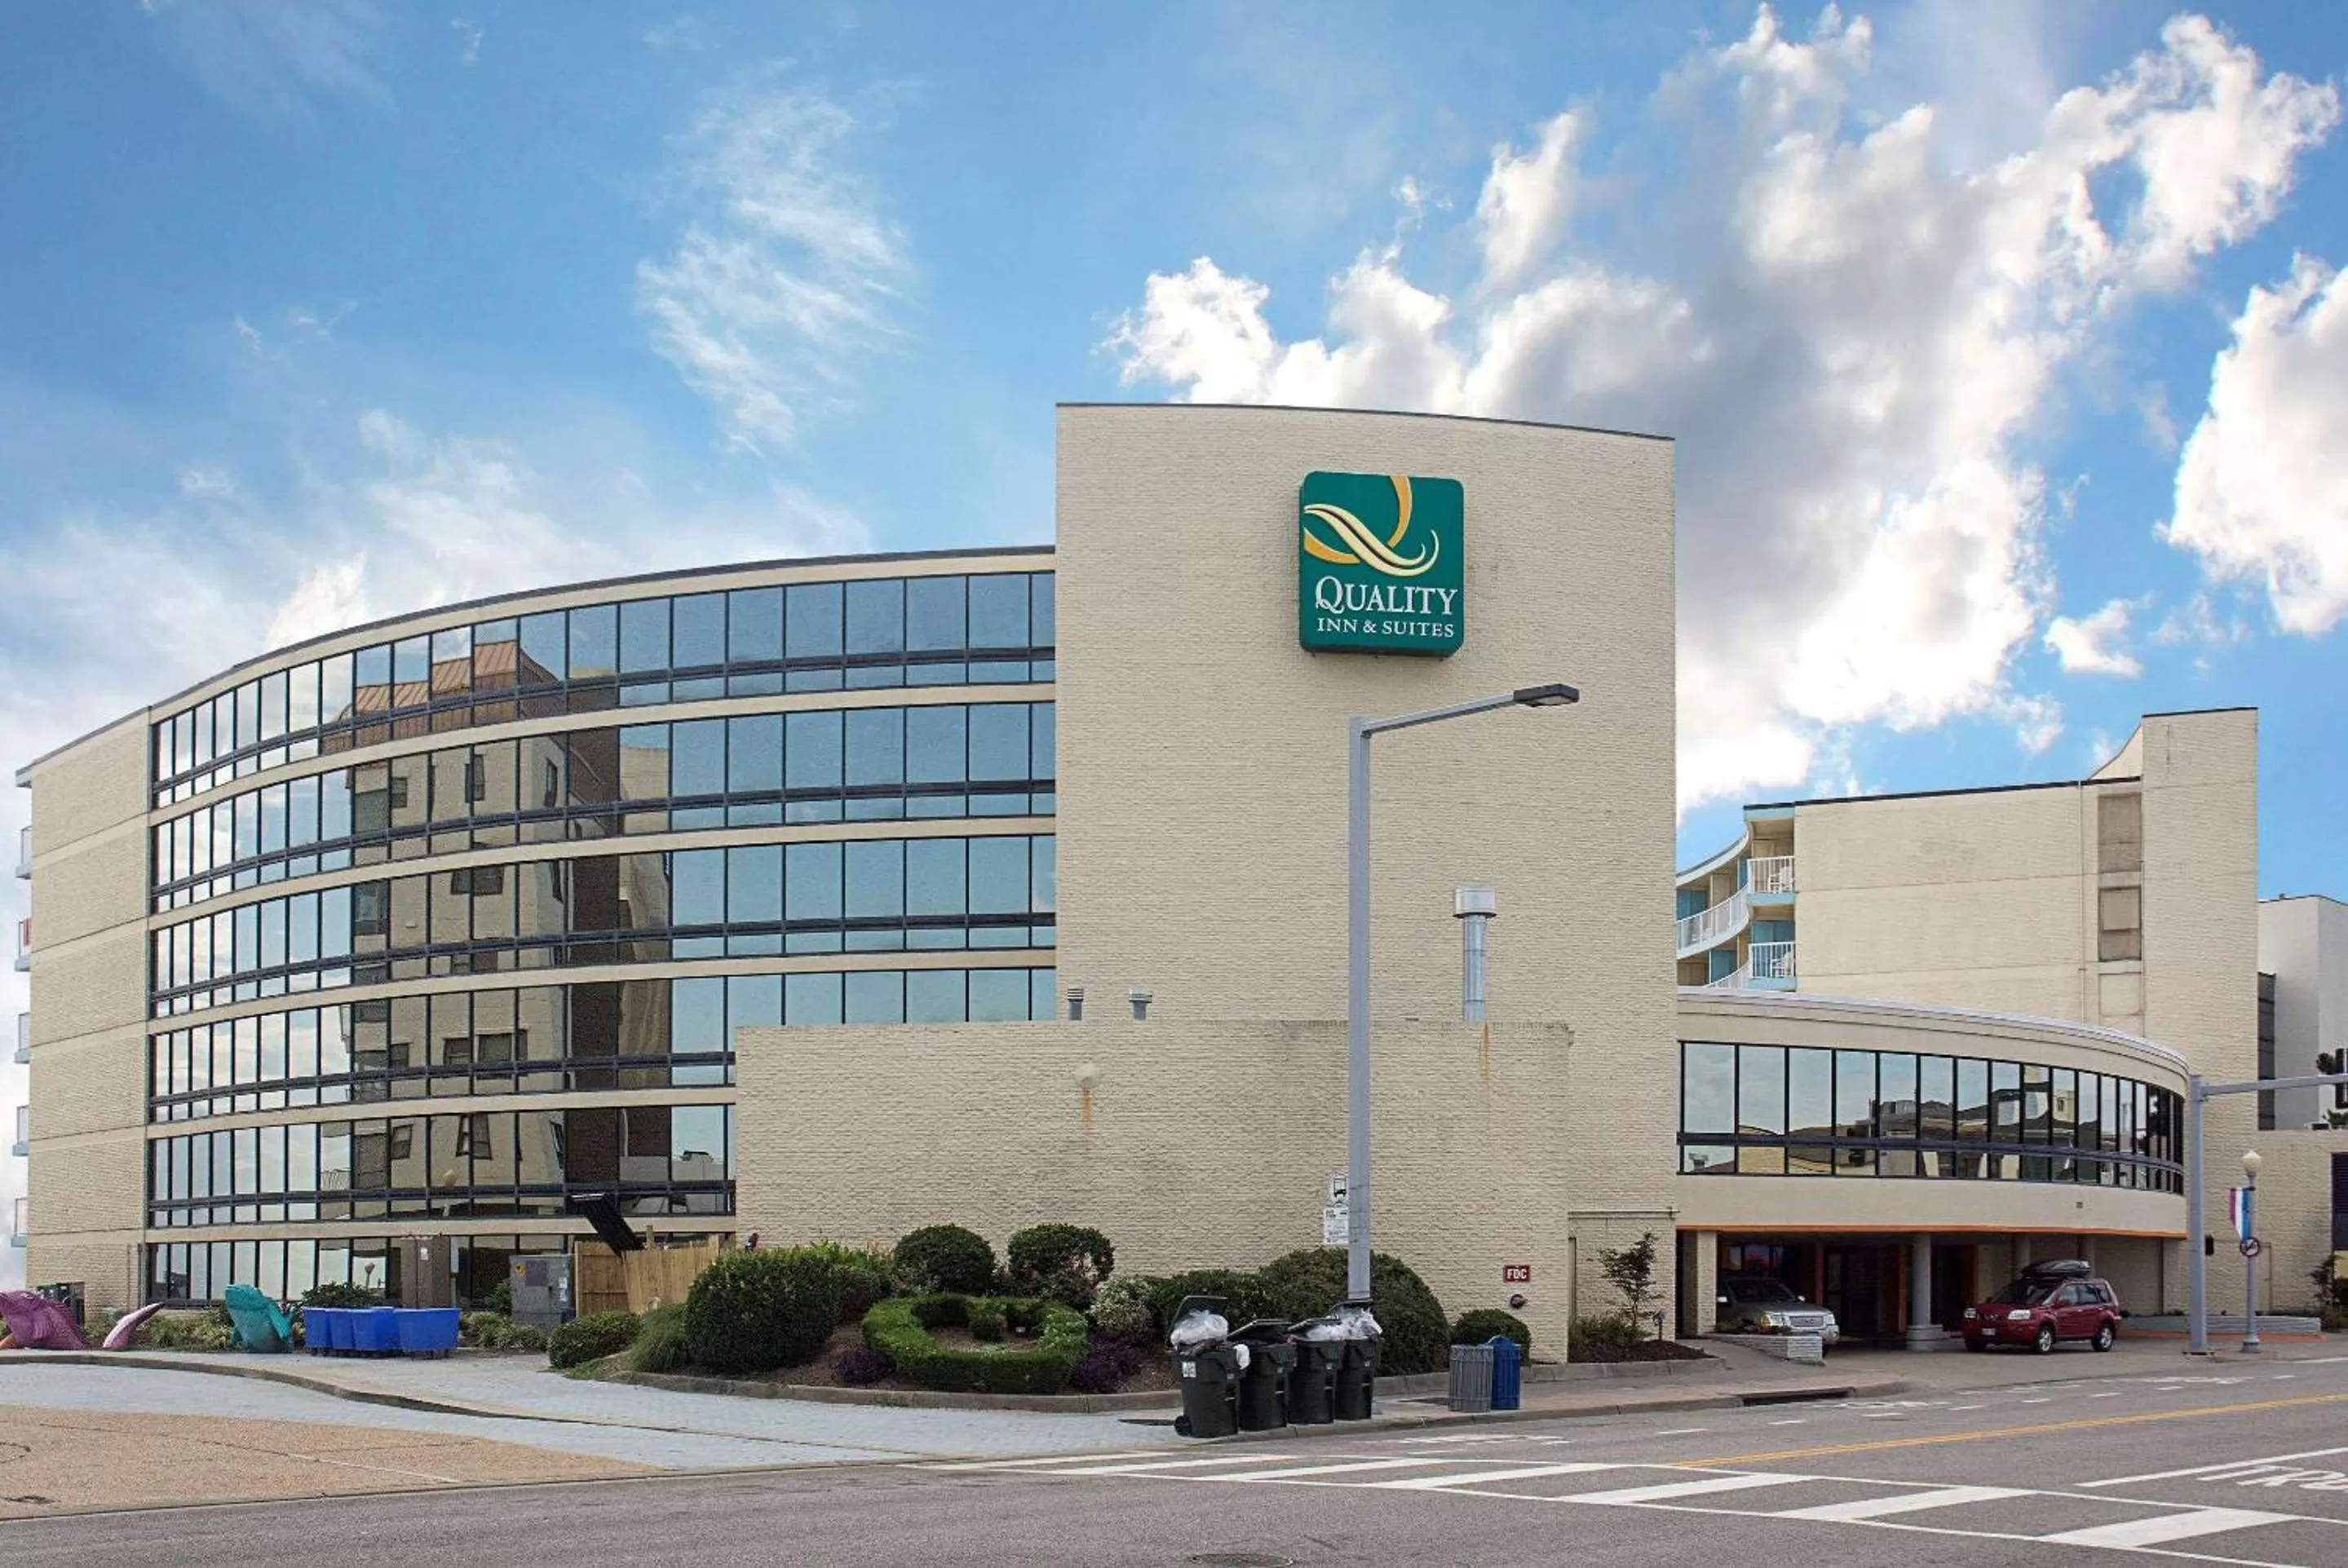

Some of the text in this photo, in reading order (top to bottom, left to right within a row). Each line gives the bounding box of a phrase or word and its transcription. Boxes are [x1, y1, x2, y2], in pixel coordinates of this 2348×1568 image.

[1315, 575, 1458, 616] QUALITY
[1317, 617, 1454, 638] INN & SUITES
[1507, 1269, 1527, 1279] FDC
